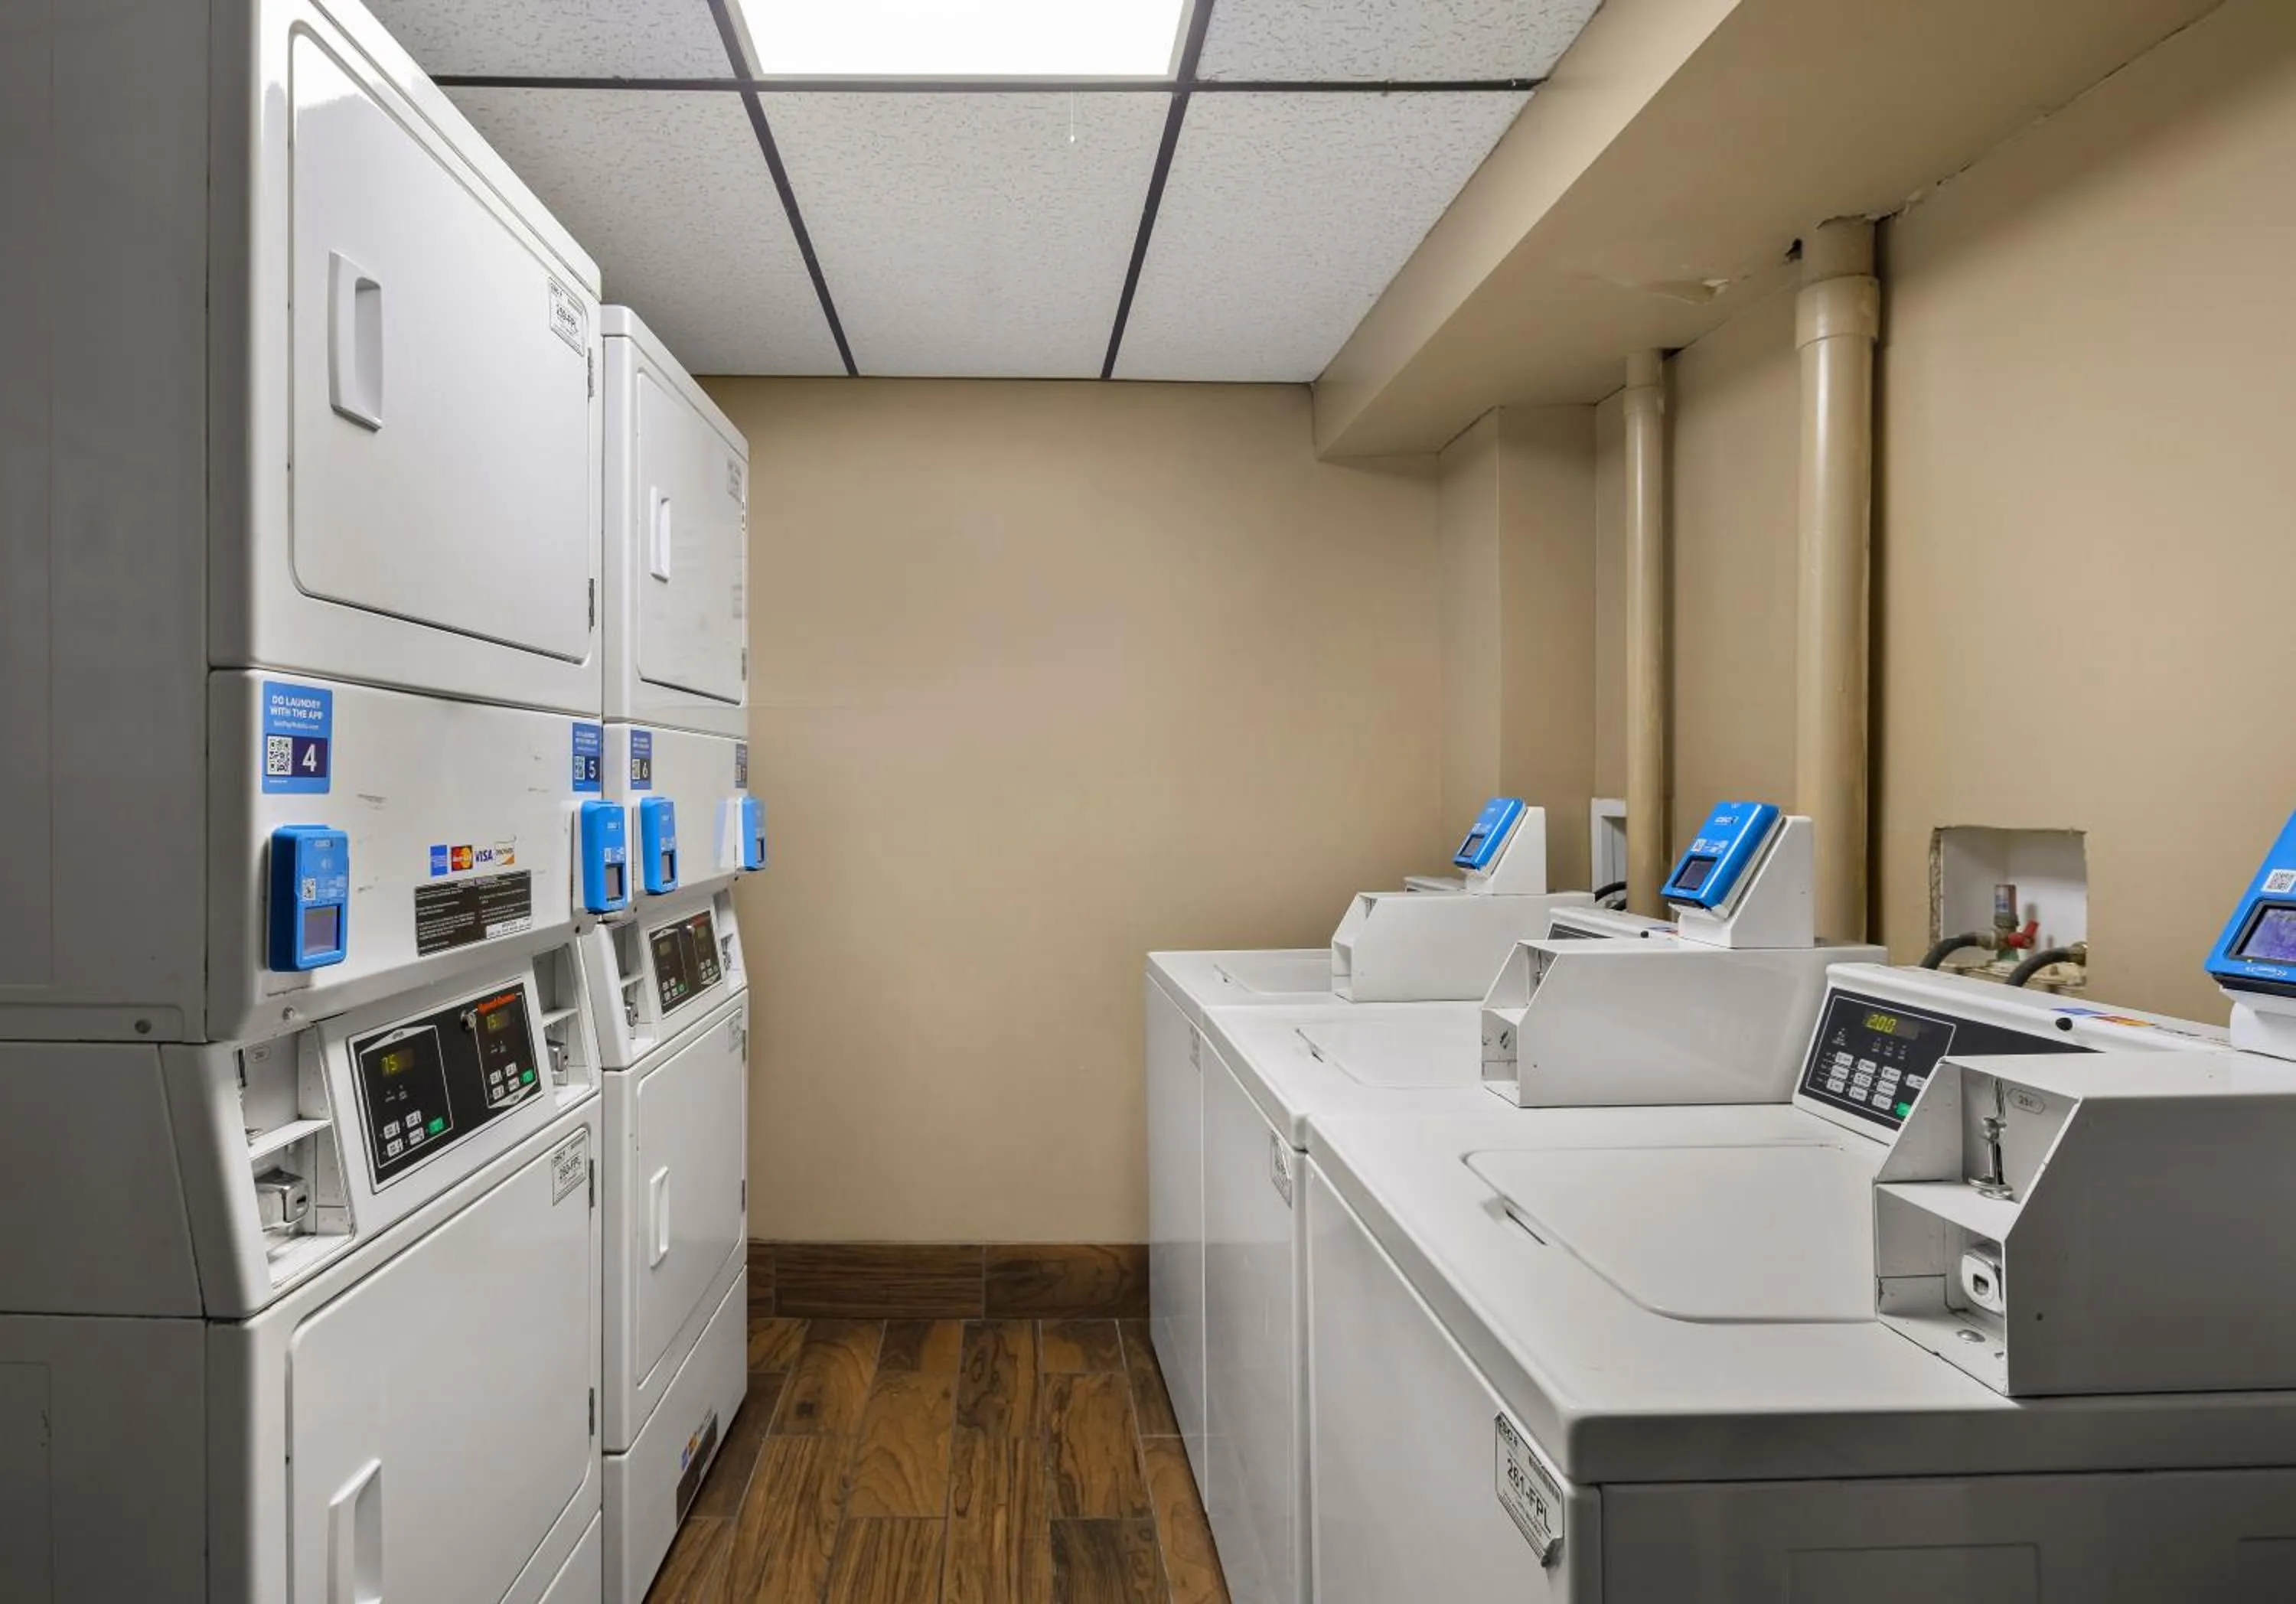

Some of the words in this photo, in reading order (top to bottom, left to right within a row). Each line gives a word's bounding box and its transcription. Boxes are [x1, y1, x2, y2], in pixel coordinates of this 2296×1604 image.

[272, 695, 285, 705] DO
[292, 708, 307, 719] THE
[302, 743, 317, 772] 4
[589, 760, 596, 779] 5
[642, 761, 648, 778] 6
[475, 849, 494, 862] VISA
